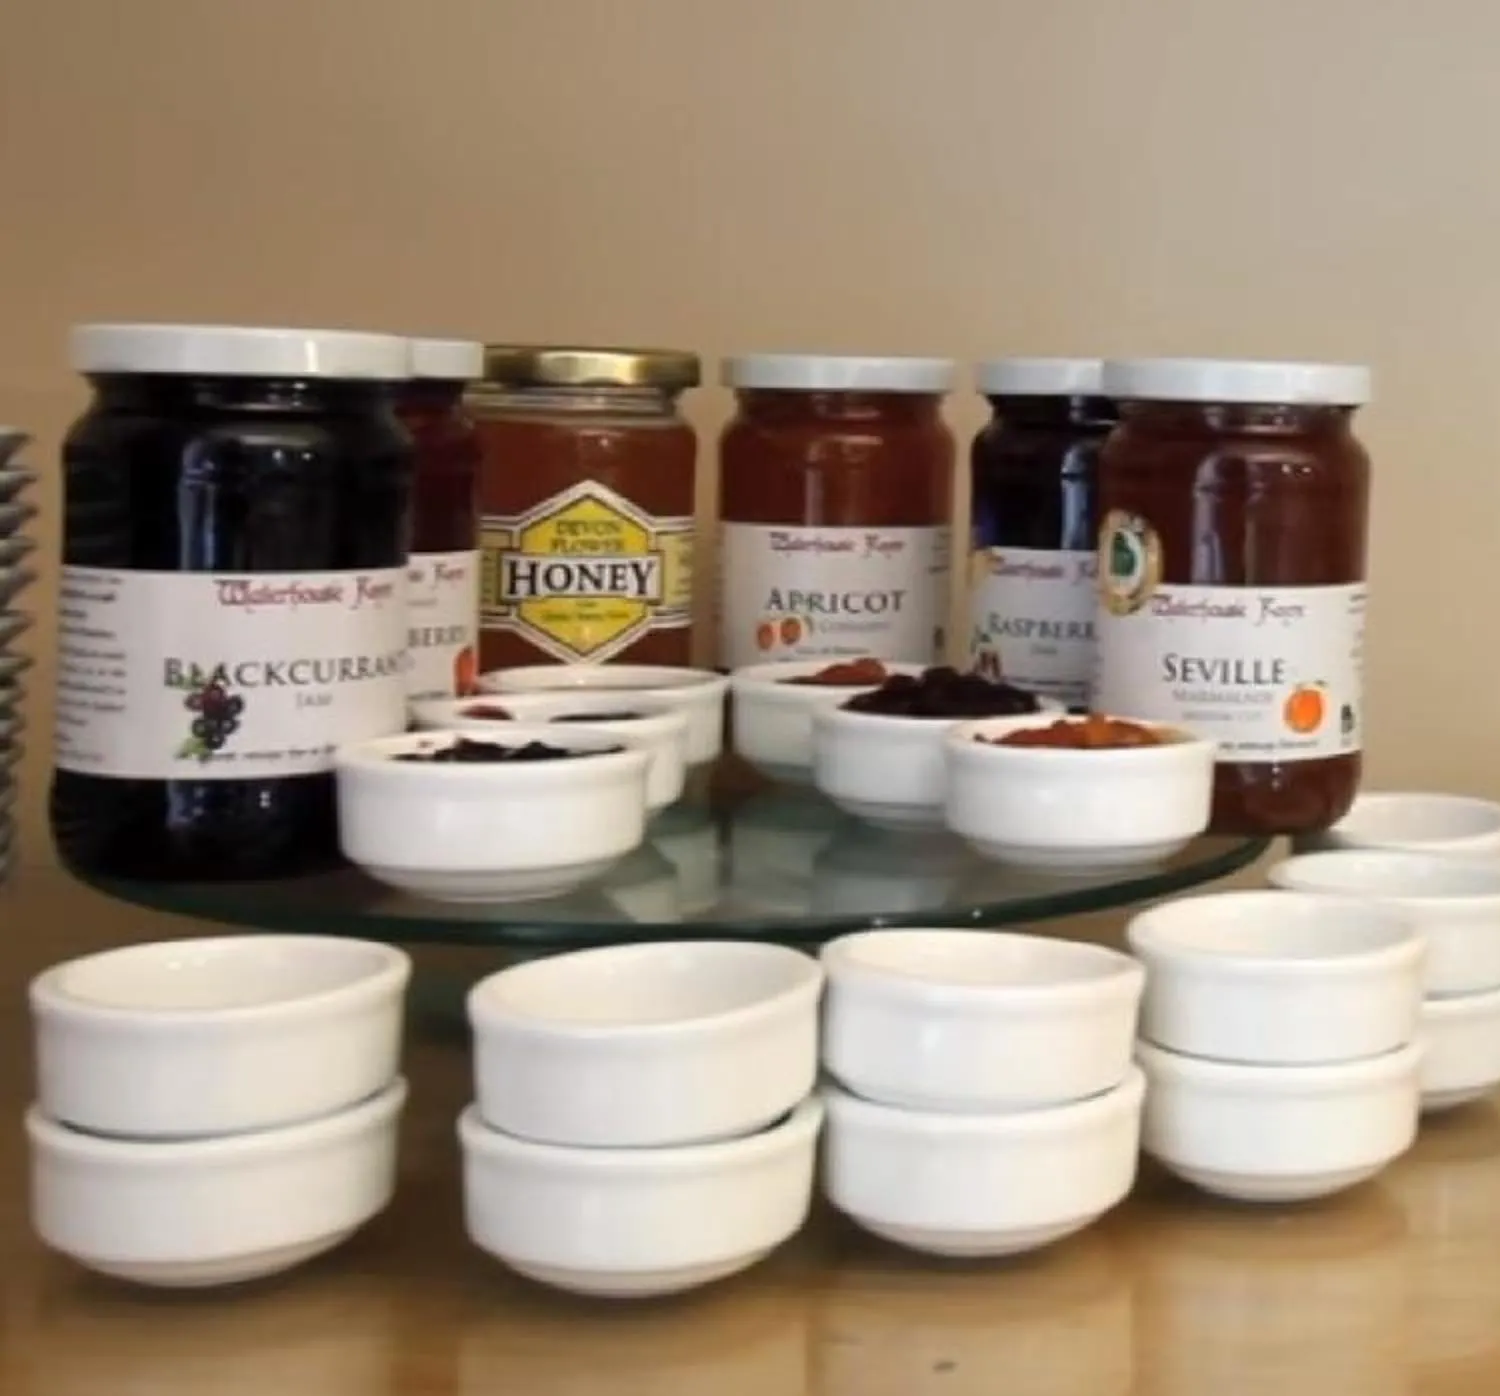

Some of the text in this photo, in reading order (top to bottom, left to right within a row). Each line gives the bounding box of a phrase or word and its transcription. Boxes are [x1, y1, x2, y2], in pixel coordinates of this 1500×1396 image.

[508, 560, 655, 596] HONEY
[765, 588, 907, 614] APRICOT
[988, 612, 1095, 638] RASPBERR
[1163, 652, 1285, 684] SEVILLE
